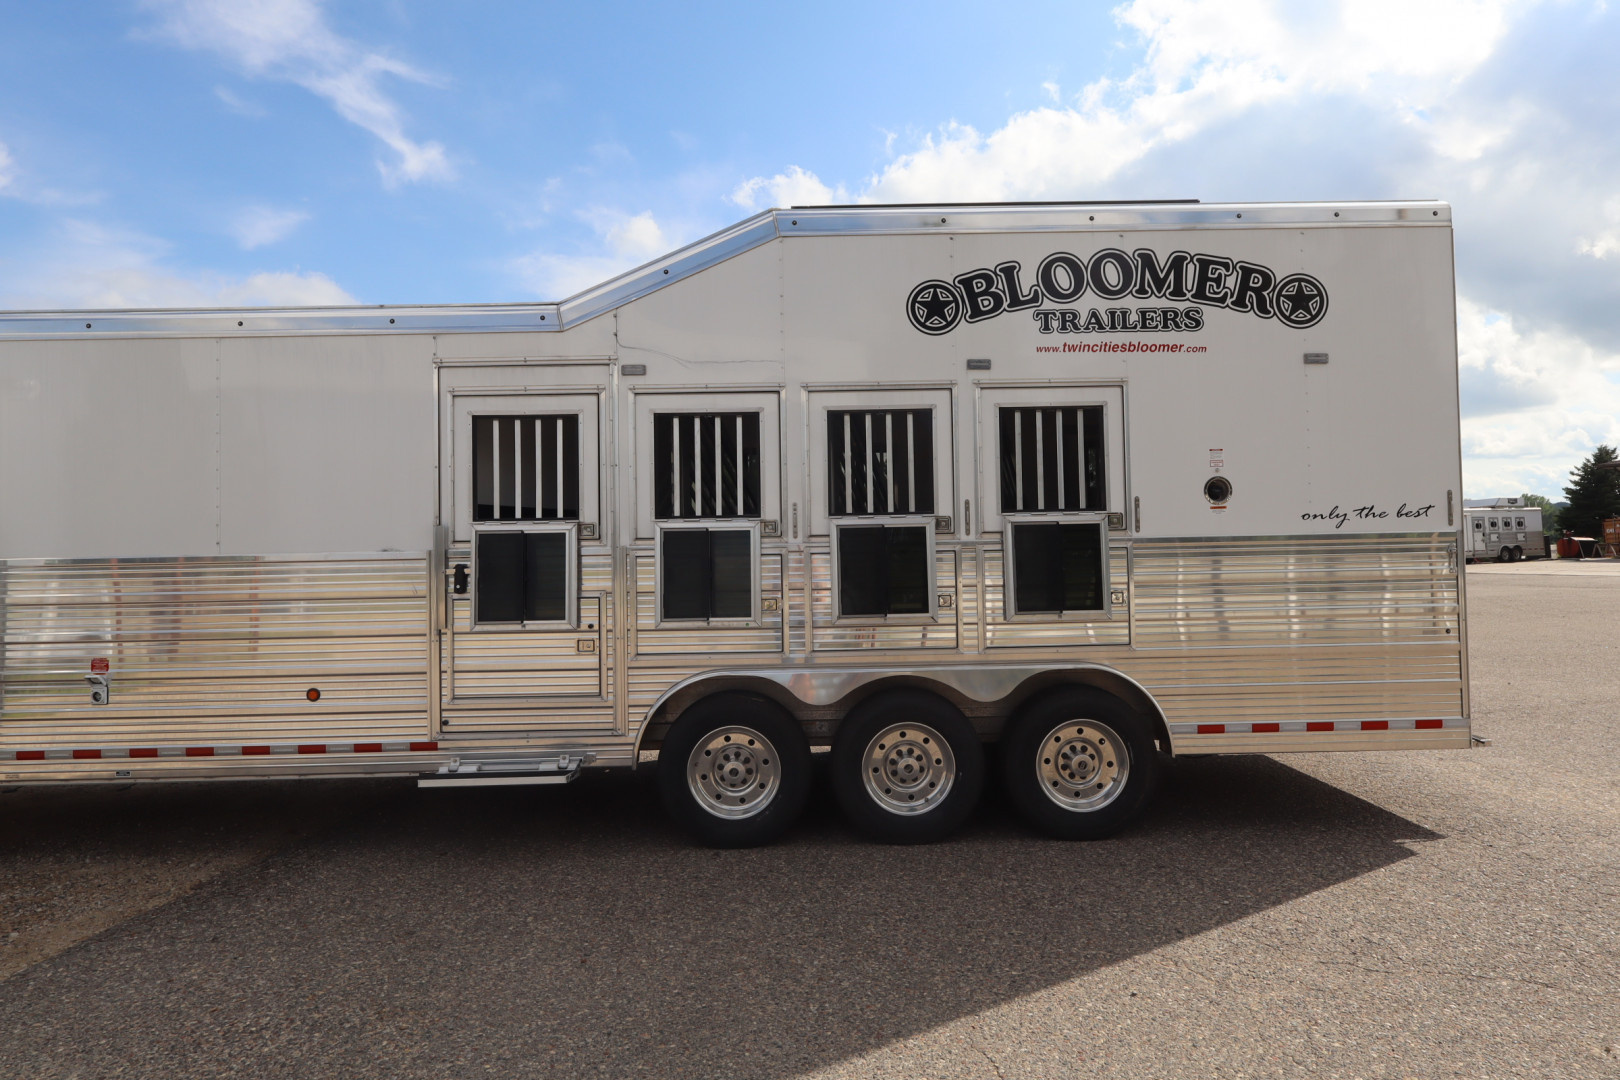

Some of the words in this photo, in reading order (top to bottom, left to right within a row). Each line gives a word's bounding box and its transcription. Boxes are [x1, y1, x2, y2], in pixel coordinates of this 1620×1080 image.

[954, 248, 1276, 323] BLOOMER
[1033, 307, 1205, 334] TRAILERS
[1036, 341, 1207, 353] www.twincitiesbloomer.com
[1301, 505, 1349, 529] only
[1353, 505, 1389, 519] the
[1396, 503, 1436, 518] best
